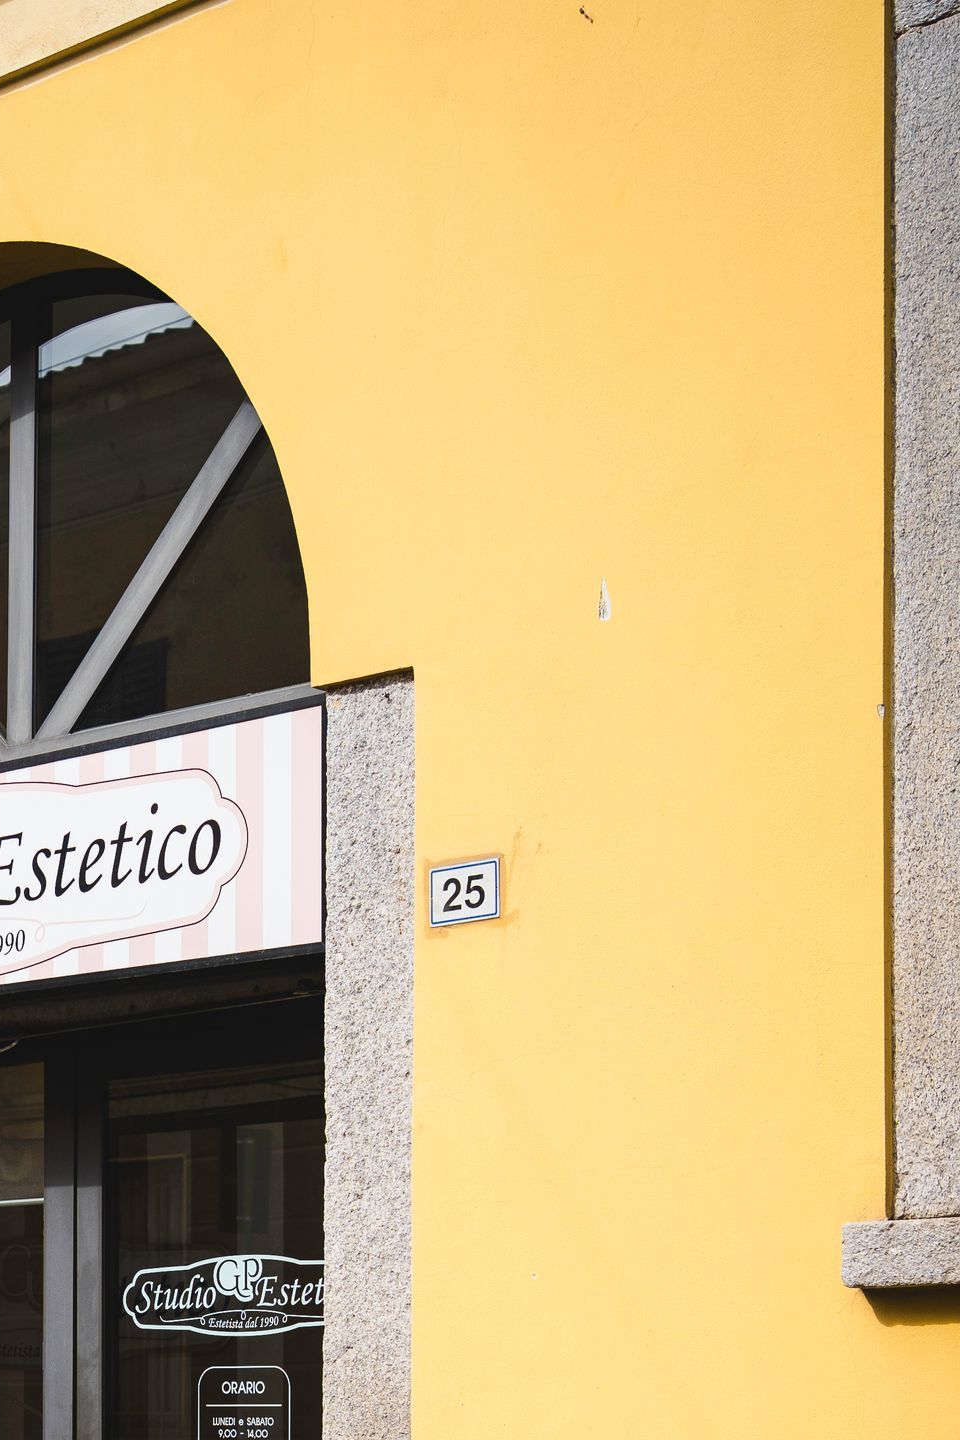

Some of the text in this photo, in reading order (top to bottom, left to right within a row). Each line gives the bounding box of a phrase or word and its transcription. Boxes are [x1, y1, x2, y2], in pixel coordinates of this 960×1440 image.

[442, 873, 486, 913] 25
[136, 1274, 216, 1313] Studio
[217, 1259, 259, 1298] GP
[208, 1317, 278, 1328] Estetista dal 1990
[222, 1381, 265, 1394] ORARIO
[213, 1417, 274, 1426] LUNEDI e SABATO
[218, 1429, 236, 1438] 9,00
[247, 1429, 268, 1438] 14,00
